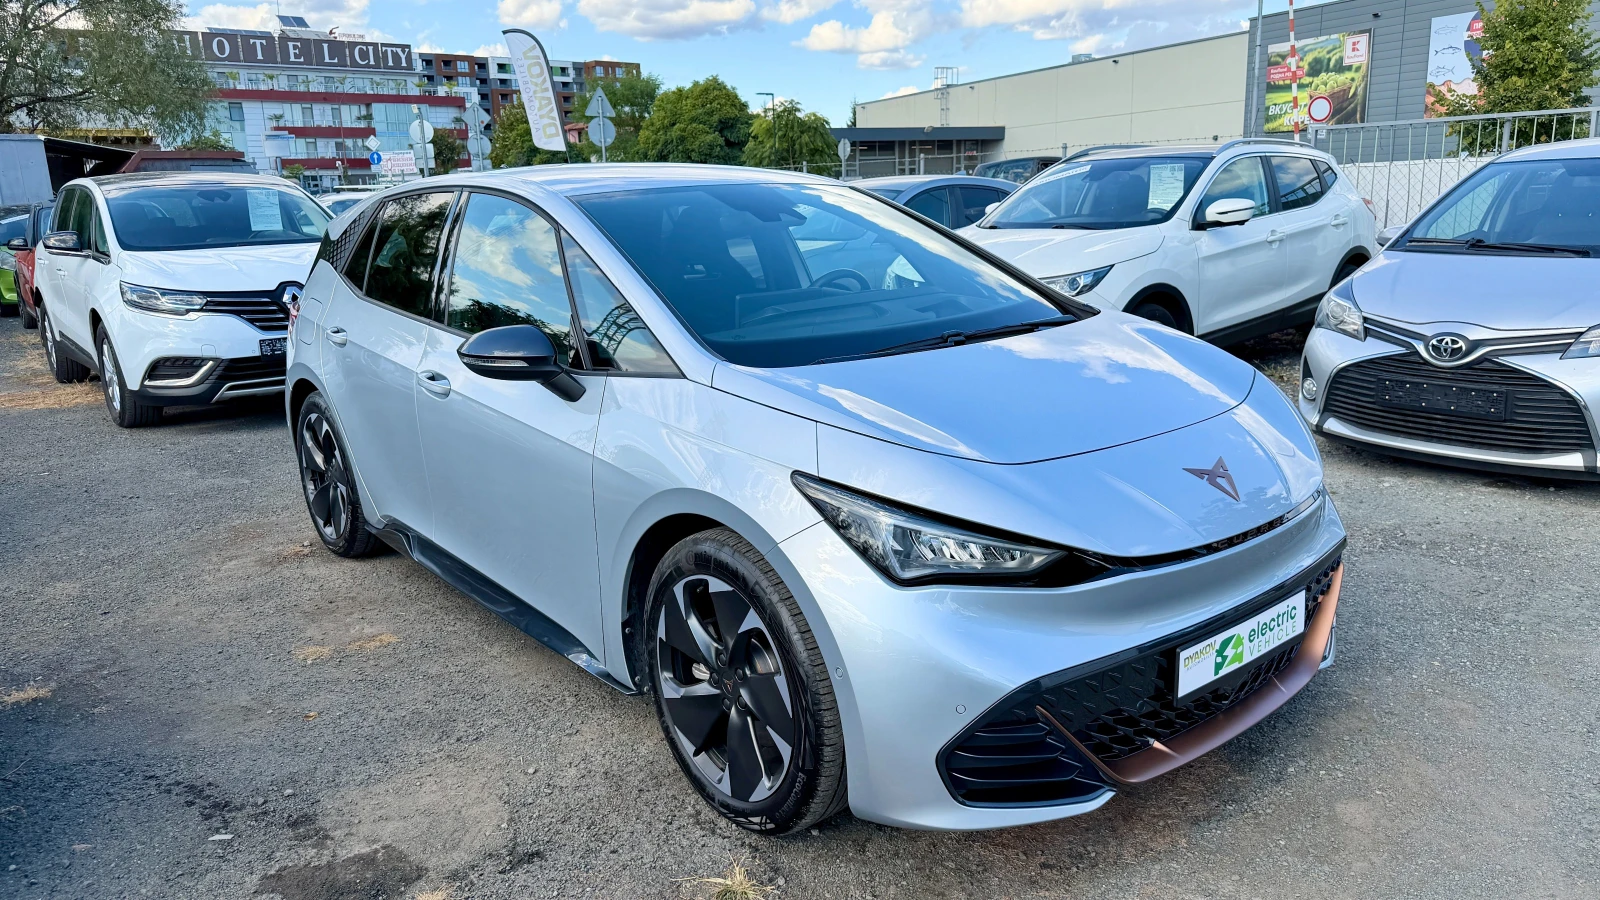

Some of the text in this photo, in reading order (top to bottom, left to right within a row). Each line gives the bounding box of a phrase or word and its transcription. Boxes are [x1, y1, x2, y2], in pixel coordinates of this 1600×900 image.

[172, 34, 410, 67] HOTEL CITY
[1217, 518, 1282, 549] CUPRA
[1247, 604, 1297, 644] electric
[1248, 620, 1297, 657] VEHICLE
[1183, 639, 1217, 669] DYAKOV
